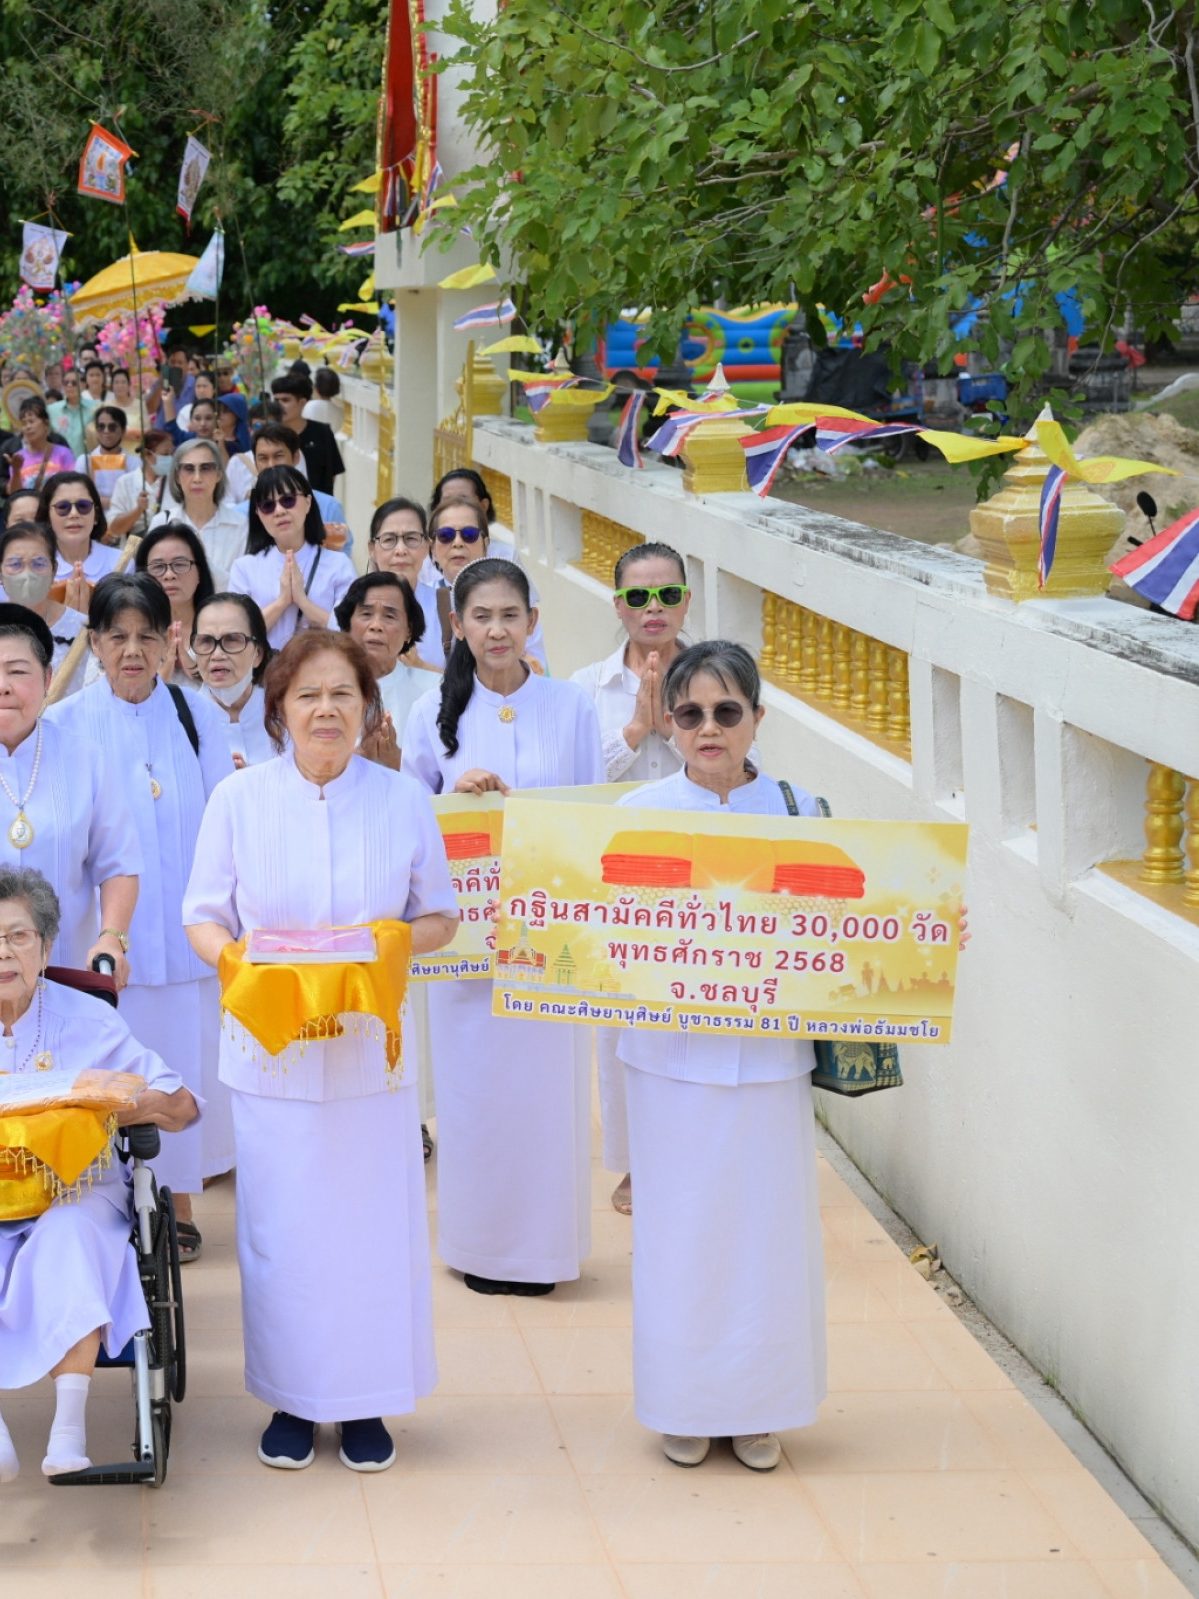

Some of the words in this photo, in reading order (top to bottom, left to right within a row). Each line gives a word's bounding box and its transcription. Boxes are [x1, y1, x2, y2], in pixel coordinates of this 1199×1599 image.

[510, 890, 777, 934] กฐินสามัคคีทั่วไทย
[791, 914, 900, 942] 30,000
[912, 913, 948, 942] วัด
[411, 957, 490, 978] ศิษยานุศิษย์
[608, 938, 762, 969] พุทธศักราช
[775, 950, 845, 973] 2568
[503, 993, 533, 1012] โดย
[540, 1000, 672, 1026] คณะศิษยานุศิษย์
[678, 1013, 753, 1030] บูชาธรรม
[760, 1017, 780, 1031] 81
[787, 1015, 799, 1032] ปี
[670, 977, 778, 1013] จ.ชลบุรี
